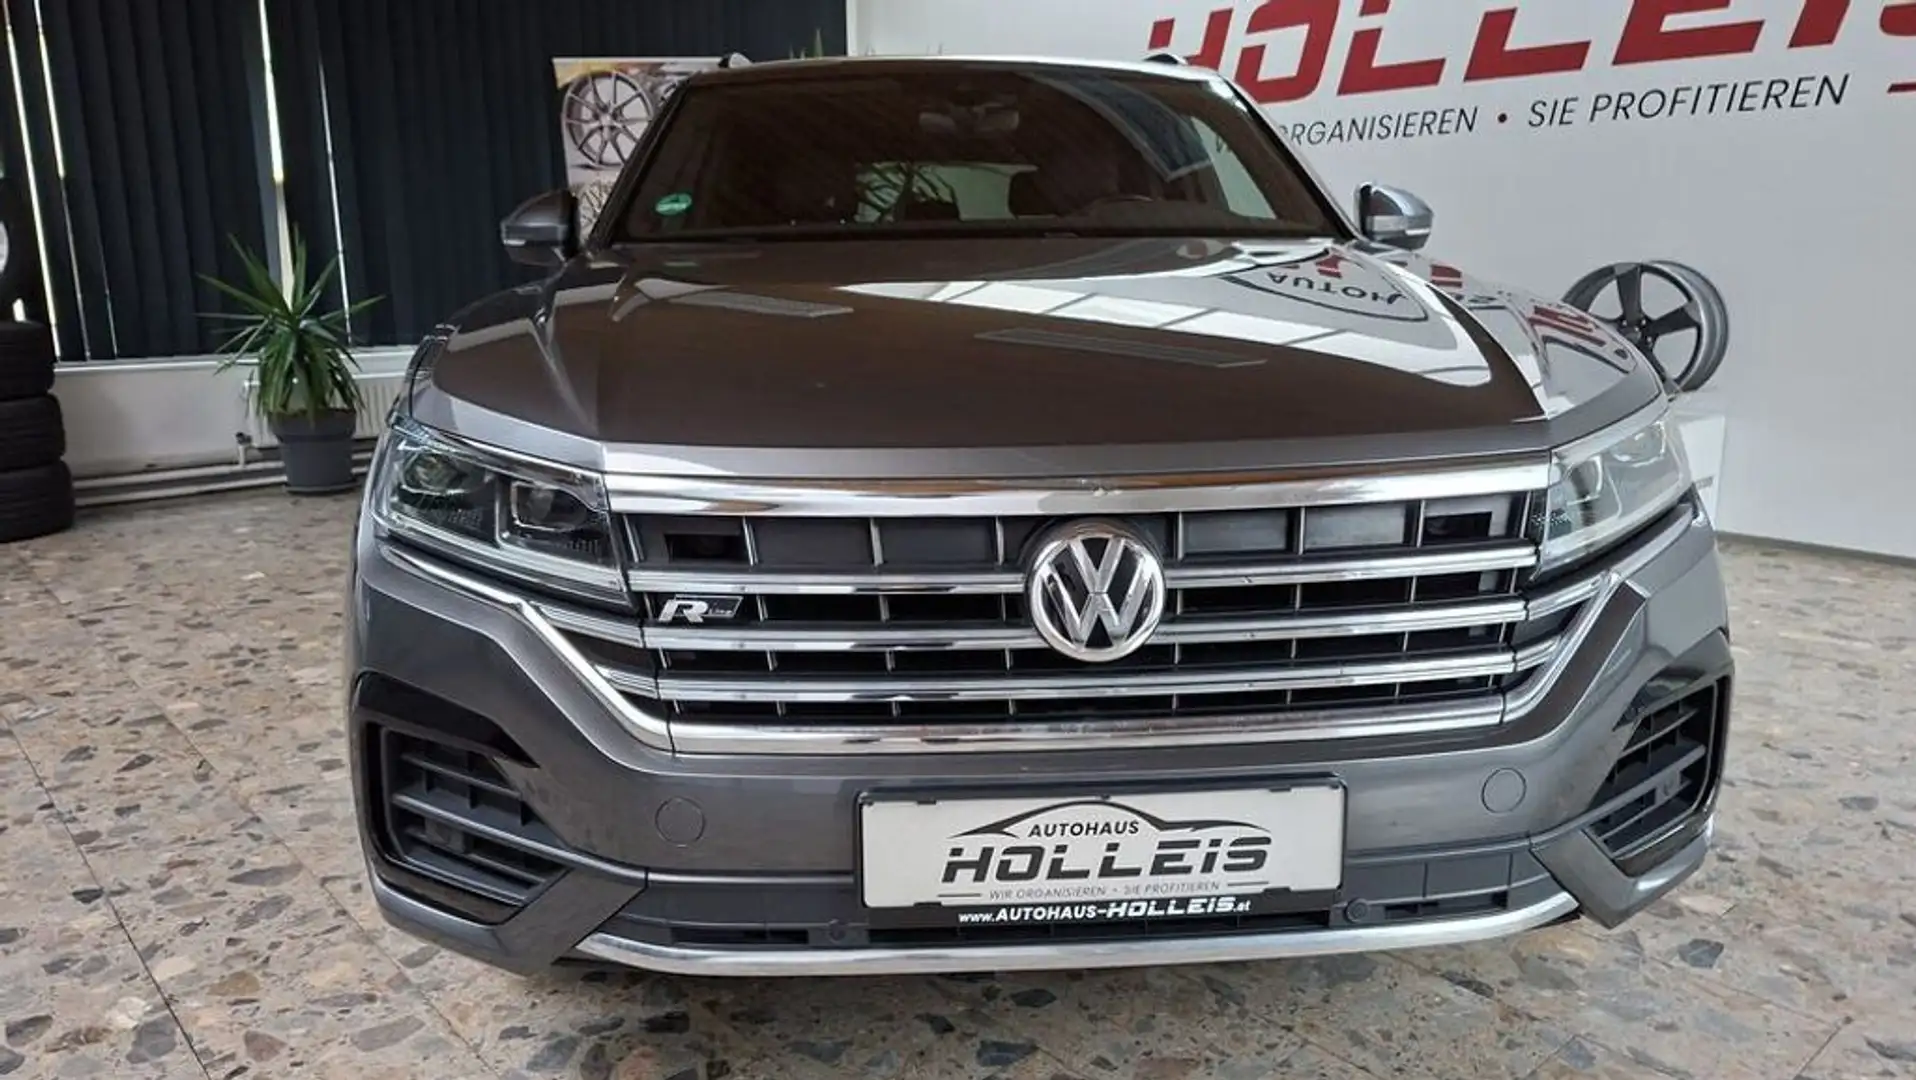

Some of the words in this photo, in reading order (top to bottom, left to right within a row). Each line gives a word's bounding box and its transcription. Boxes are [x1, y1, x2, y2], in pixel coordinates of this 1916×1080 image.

[1528, 96, 1579, 128] SIE
[1588, 72, 1851, 123] PROFITIEREN
[1036, 530, 1158, 655] VW
[1028, 820, 1140, 838] AUTOHAUS
[941, 836, 1272, 884] HOLLEIS
[958, 896, 1251, 923] www.AUTOHAUS-HOLLEIS.at
